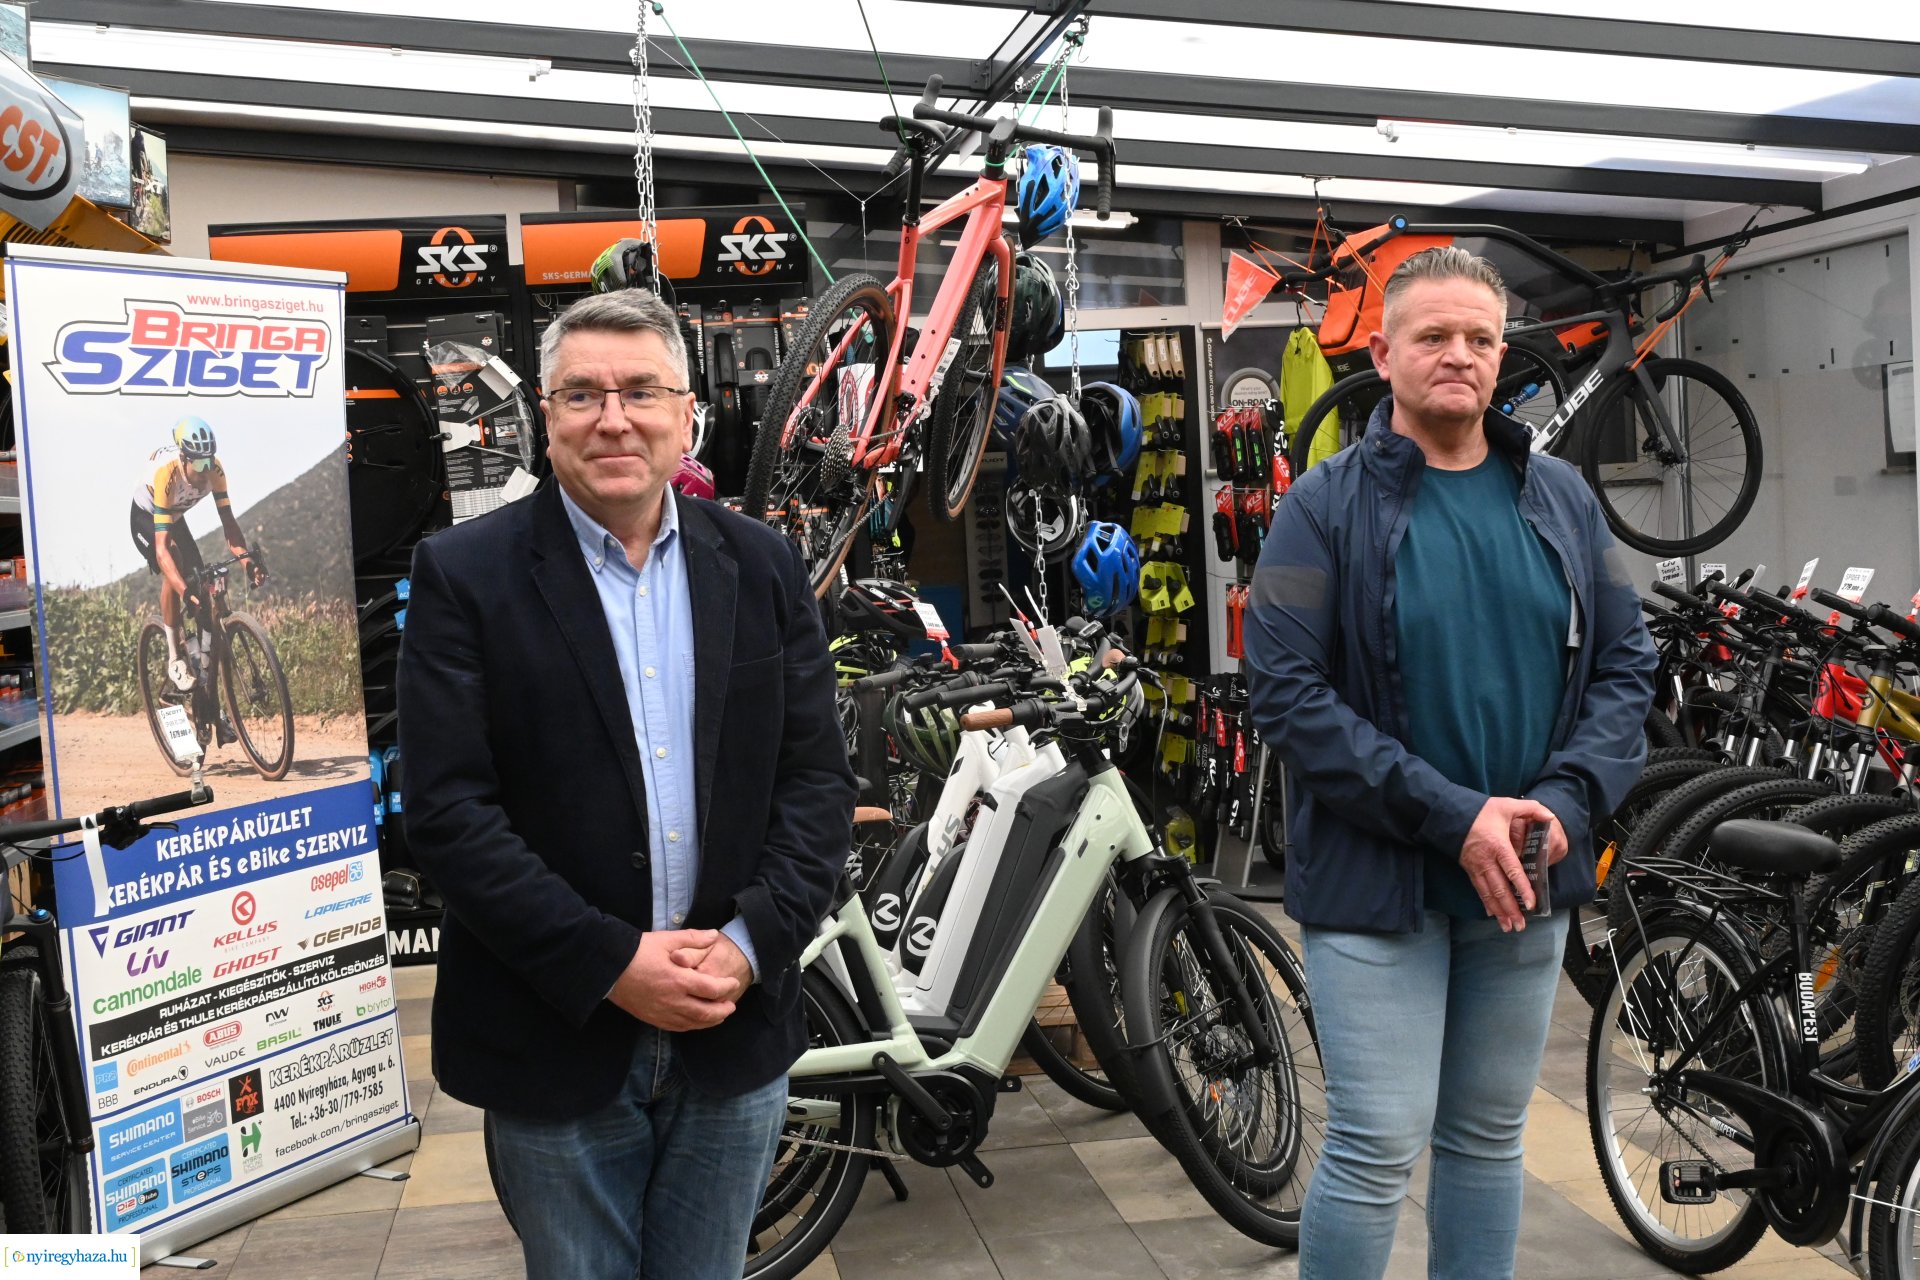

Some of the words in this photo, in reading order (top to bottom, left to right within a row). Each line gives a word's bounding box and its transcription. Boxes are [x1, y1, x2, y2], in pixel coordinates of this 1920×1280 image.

[0, 105, 61, 185] CST
[416, 244, 488, 273] SKS
[718, 233, 788, 261] SKS
[416, 275, 496, 285] GERMANY
[542, 271, 592, 280] SKS-GERMA
[717, 263, 794, 273] GERMANY
[187, 294, 324, 313] www.bringasziget.hu
[1223, 270, 1258, 327] CUBE
[1505, 321, 1525, 329] BE
[61, 330, 322, 389] SZIGET
[1540, 369, 1604, 445] CUBE
[157, 807, 312, 862] KERÉKPÁRÜZLET
[209, 854, 232, 882] ÉS
[237, 846, 291, 874] eBike
[295, 824, 368, 860] SZERVIZ
[304, 893, 373, 920] LAPIERRE
[114, 909, 196, 949] GIANT
[213, 946, 282, 979] GHOST
[93, 966, 202, 1015] cannondale
[160, 993, 211, 1019] RUHÁZAT
[218, 970, 287, 1000] KIEGÉSZÍTŐK
[293, 955, 335, 976] SZERVIZ
[359, 976, 386, 992] HIGH5
[101, 1027, 163, 1056] KERÉKPÁR
[164, 1021, 178, 1035] ÉS
[180, 1009, 215, 1030] THULE
[216, 974, 319, 1017] KERÉKPÁRSZÁLLÍTÓ
[321, 954, 385, 981] KÖLCSÖNZÉS
[317, 995, 335, 1008] SKS
[367, 997, 392, 1012] bryton
[1798, 972, 1819, 1044] BUDAPEST
[208, 1025, 237, 1043] ABUS
[313, 1012, 342, 1032] THULE
[256, 1031, 302, 1051] BASIL
[126, 1043, 182, 1077] Continental
[205, 1046, 246, 1068] VAUDE
[268, 1028, 394, 1089] KERÉKPÁRÜZLET
[133, 1075, 178, 1095] ENDURA
[196, 1088, 221, 1103] BOSCH
[274, 1092, 296, 1112] 4400
[298, 1073, 349, 1106] Nyíregyháza,
[352, 1063, 376, 1084] Agyag
[379, 1062, 386, 1072] u.
[388, 1055, 395, 1068] 6.
[98, 1093, 118, 1109] BBB
[235, 1091, 259, 1112] FOX
[290, 1110, 307, 1131] Tel.:
[309, 1080, 384, 1122] +36-30/779-7585
[109, 1112, 174, 1149] SHIMANO
[188, 1123, 206, 1134] Service
[275, 1100, 399, 1158] facebook.com/bringasziget
[111, 1145, 142, 1162] SERVICE
[143, 1132, 176, 1148] CENTER
[182, 1141, 217, 1160] CERTIFICATED
[118, 1166, 154, 1187] CERTIFICATED
[171, 1146, 229, 1179] SHIMANO
[106, 1172, 166, 1206] SHIMANO
[183, 1176, 221, 1197] PROFESSIONAL
[119, 1203, 158, 1224] PROFESSIONAL
